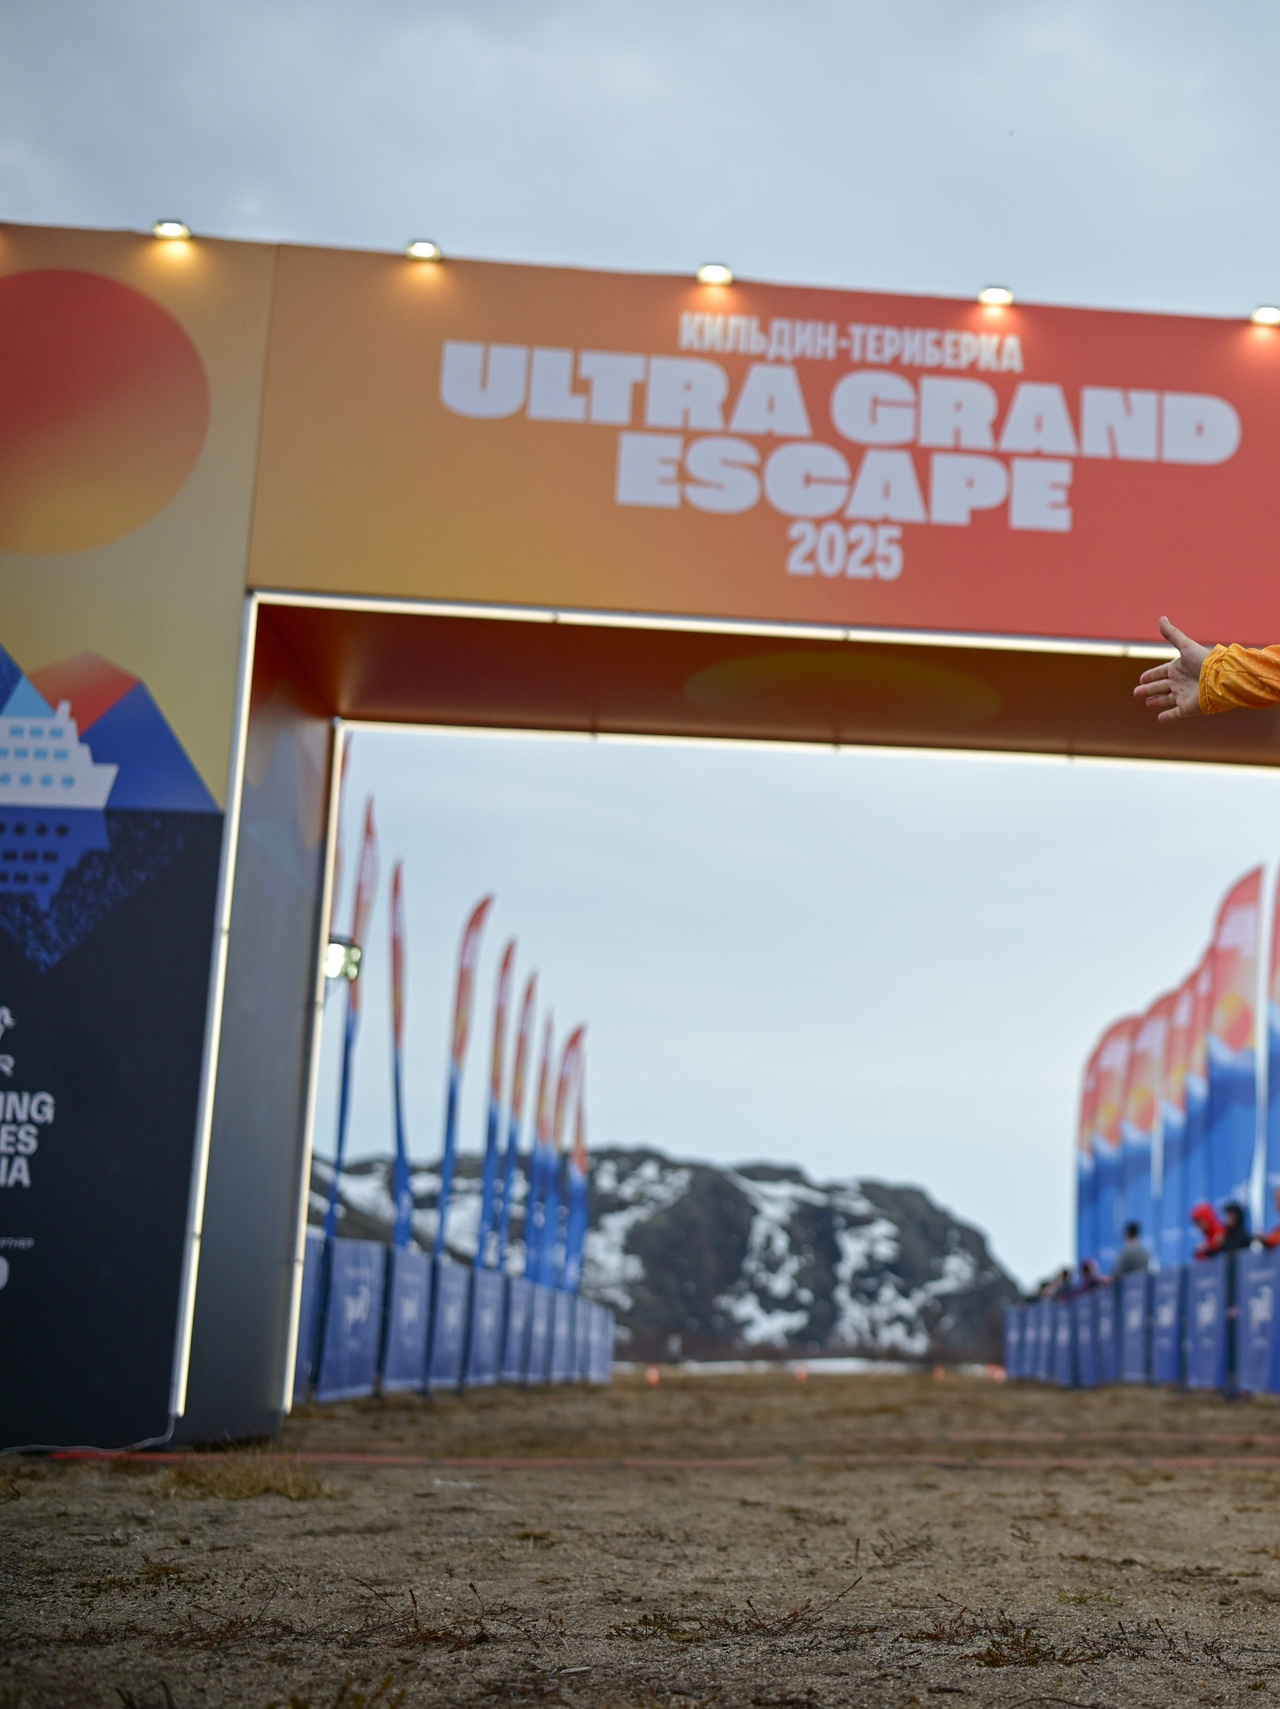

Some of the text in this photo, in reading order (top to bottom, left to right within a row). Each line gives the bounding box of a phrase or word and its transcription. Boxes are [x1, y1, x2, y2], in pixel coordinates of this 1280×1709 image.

[679, 311, 1023, 373] КИЛЬДИН-ТЕРИБЕРКА
[440, 340, 1241, 466] ULTRA GRAND
[615, 431, 1073, 532] ESCAPE
[786, 520, 904, 581] 2025
